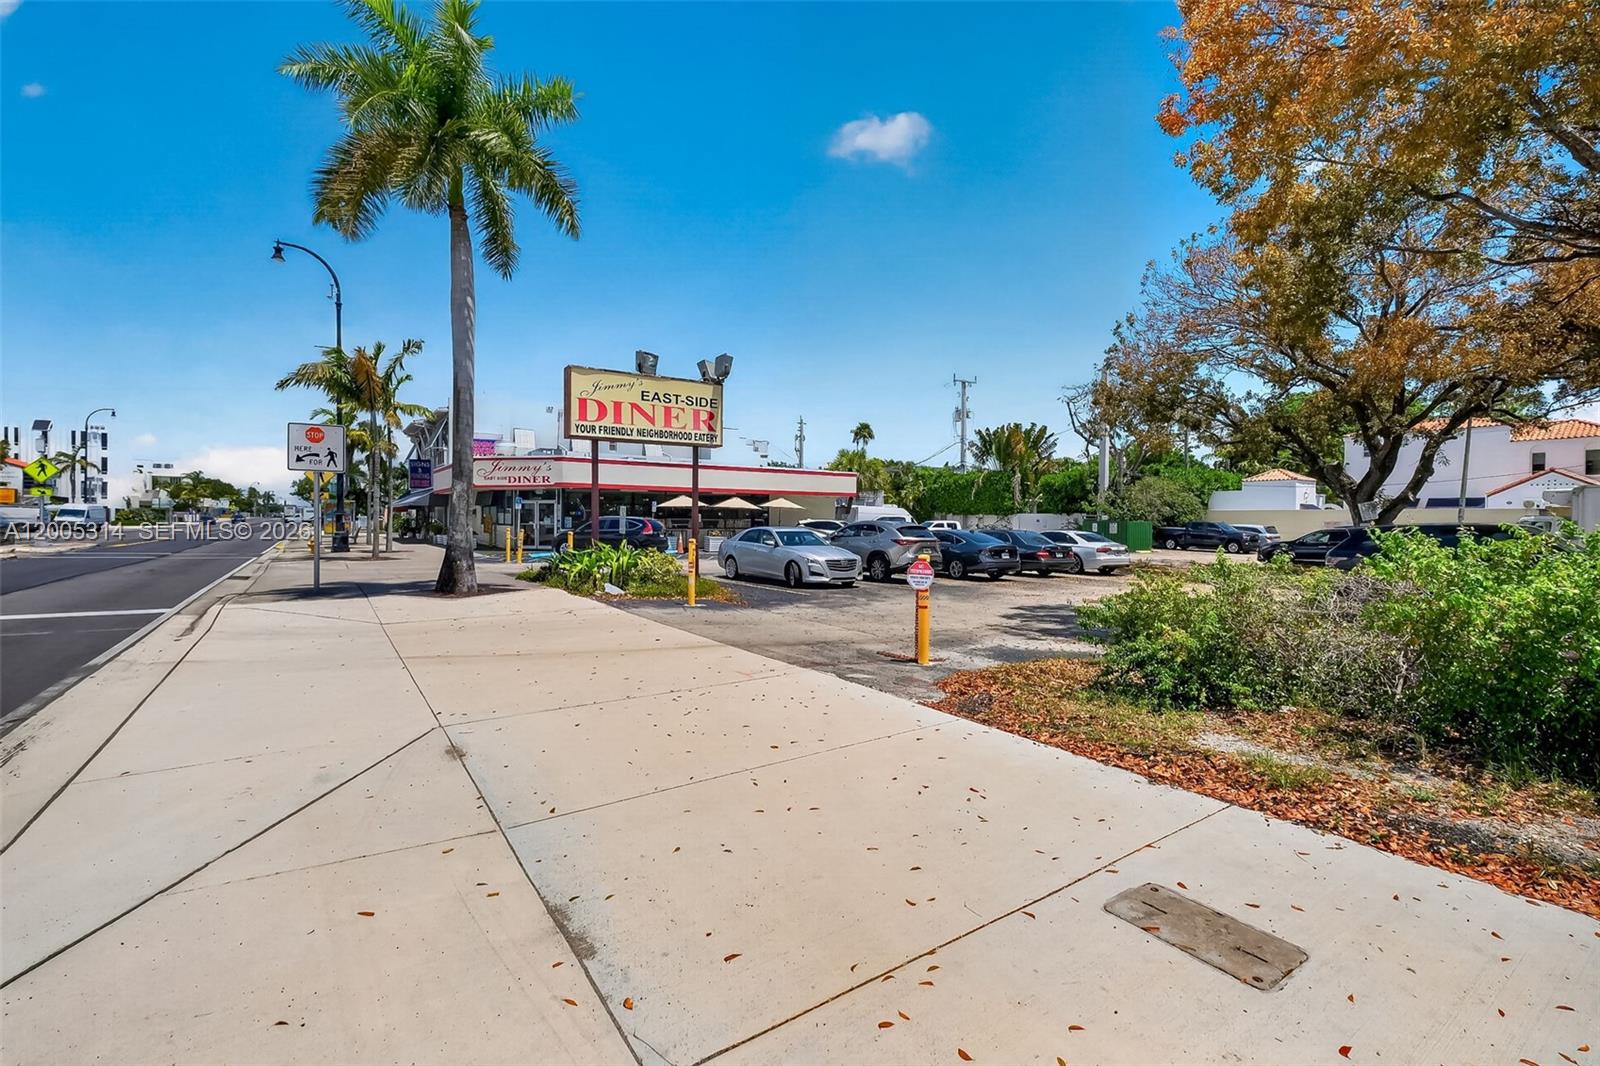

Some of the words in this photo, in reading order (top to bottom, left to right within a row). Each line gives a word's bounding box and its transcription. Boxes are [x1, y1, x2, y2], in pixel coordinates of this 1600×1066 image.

[579, 378, 644, 397] Jimmy's
[640, 390, 719, 409] EAST-SIDE
[576, 397, 717, 432] DINER
[306, 431, 324, 439] STOP
[574, 423, 597, 434] YOUR
[598, 425, 635, 437] FRIENDLY
[636, 428, 693, 442] NEIGHBORHOOD
[693, 432, 719, 443] EATERY
[476, 459, 552, 477] Jimmy's
[508, 475, 551, 484] DINER
